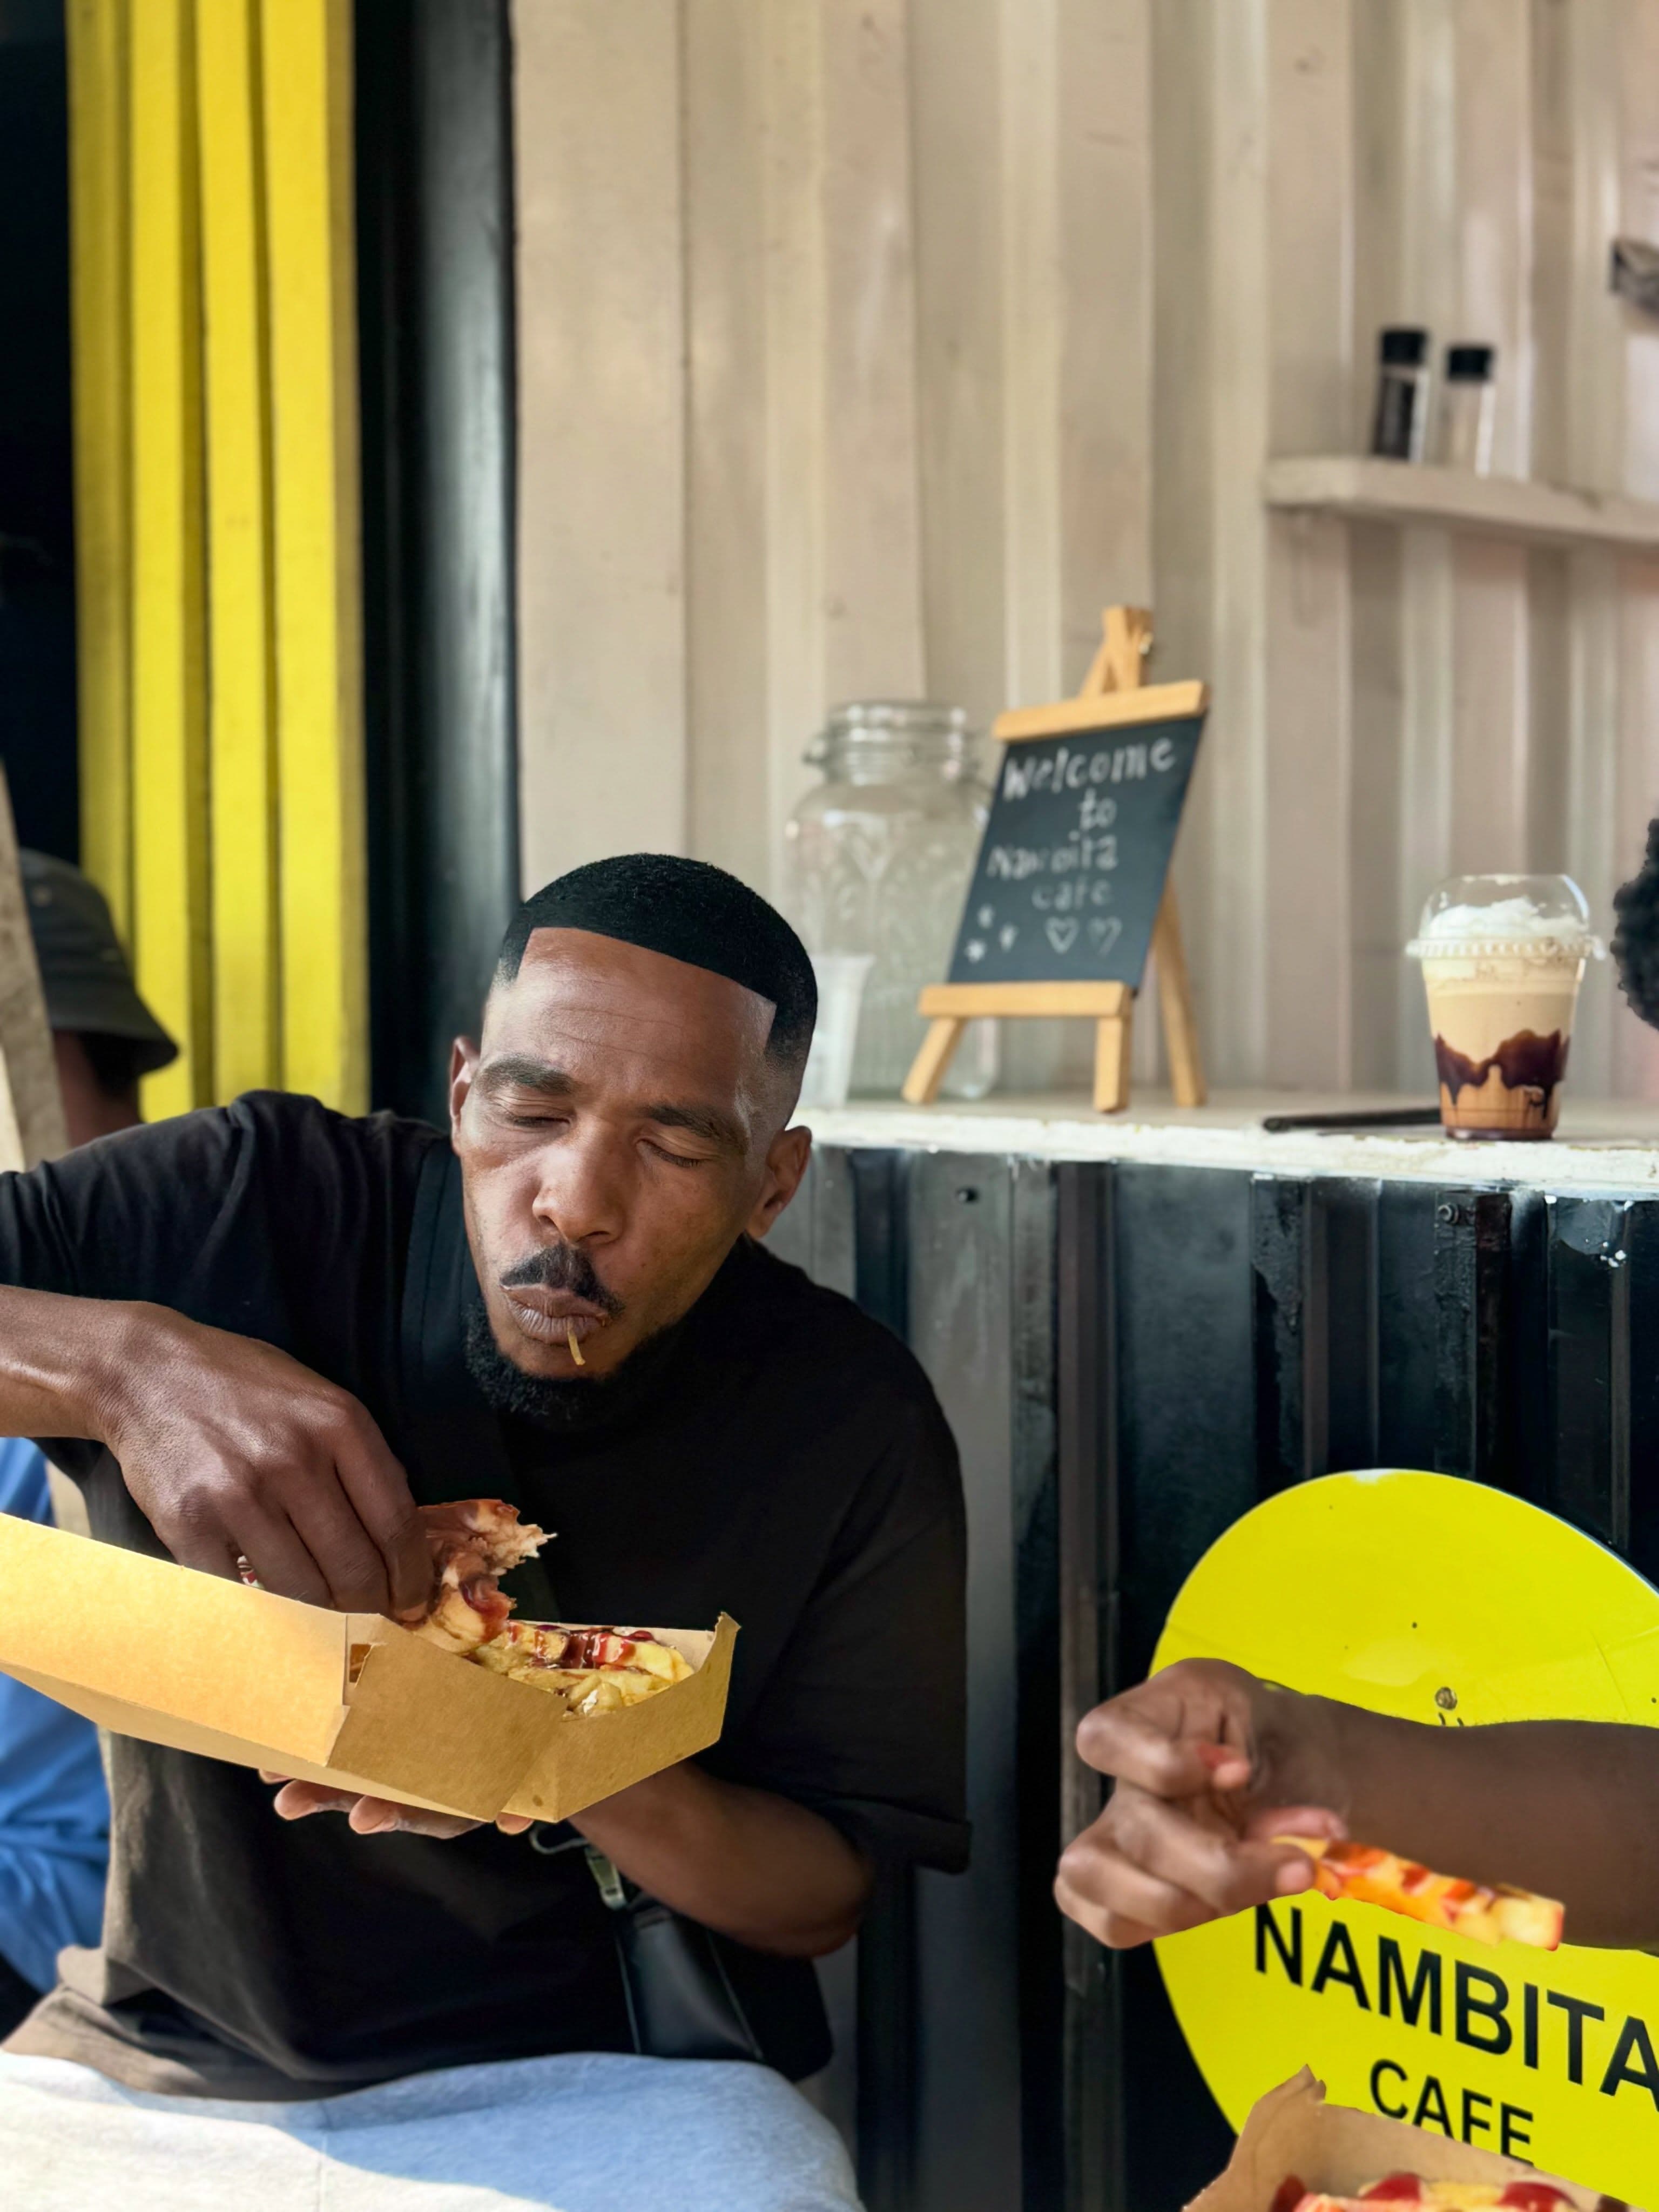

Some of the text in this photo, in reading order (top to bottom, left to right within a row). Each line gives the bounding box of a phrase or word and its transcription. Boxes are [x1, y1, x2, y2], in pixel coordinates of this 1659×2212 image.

[1003, 738, 1176, 800] Welcome
[1079, 788, 1117, 831] to
[1255, 1903, 1659, 2112] NAMBITA
[1370, 2059, 1534, 2167] CAFE
